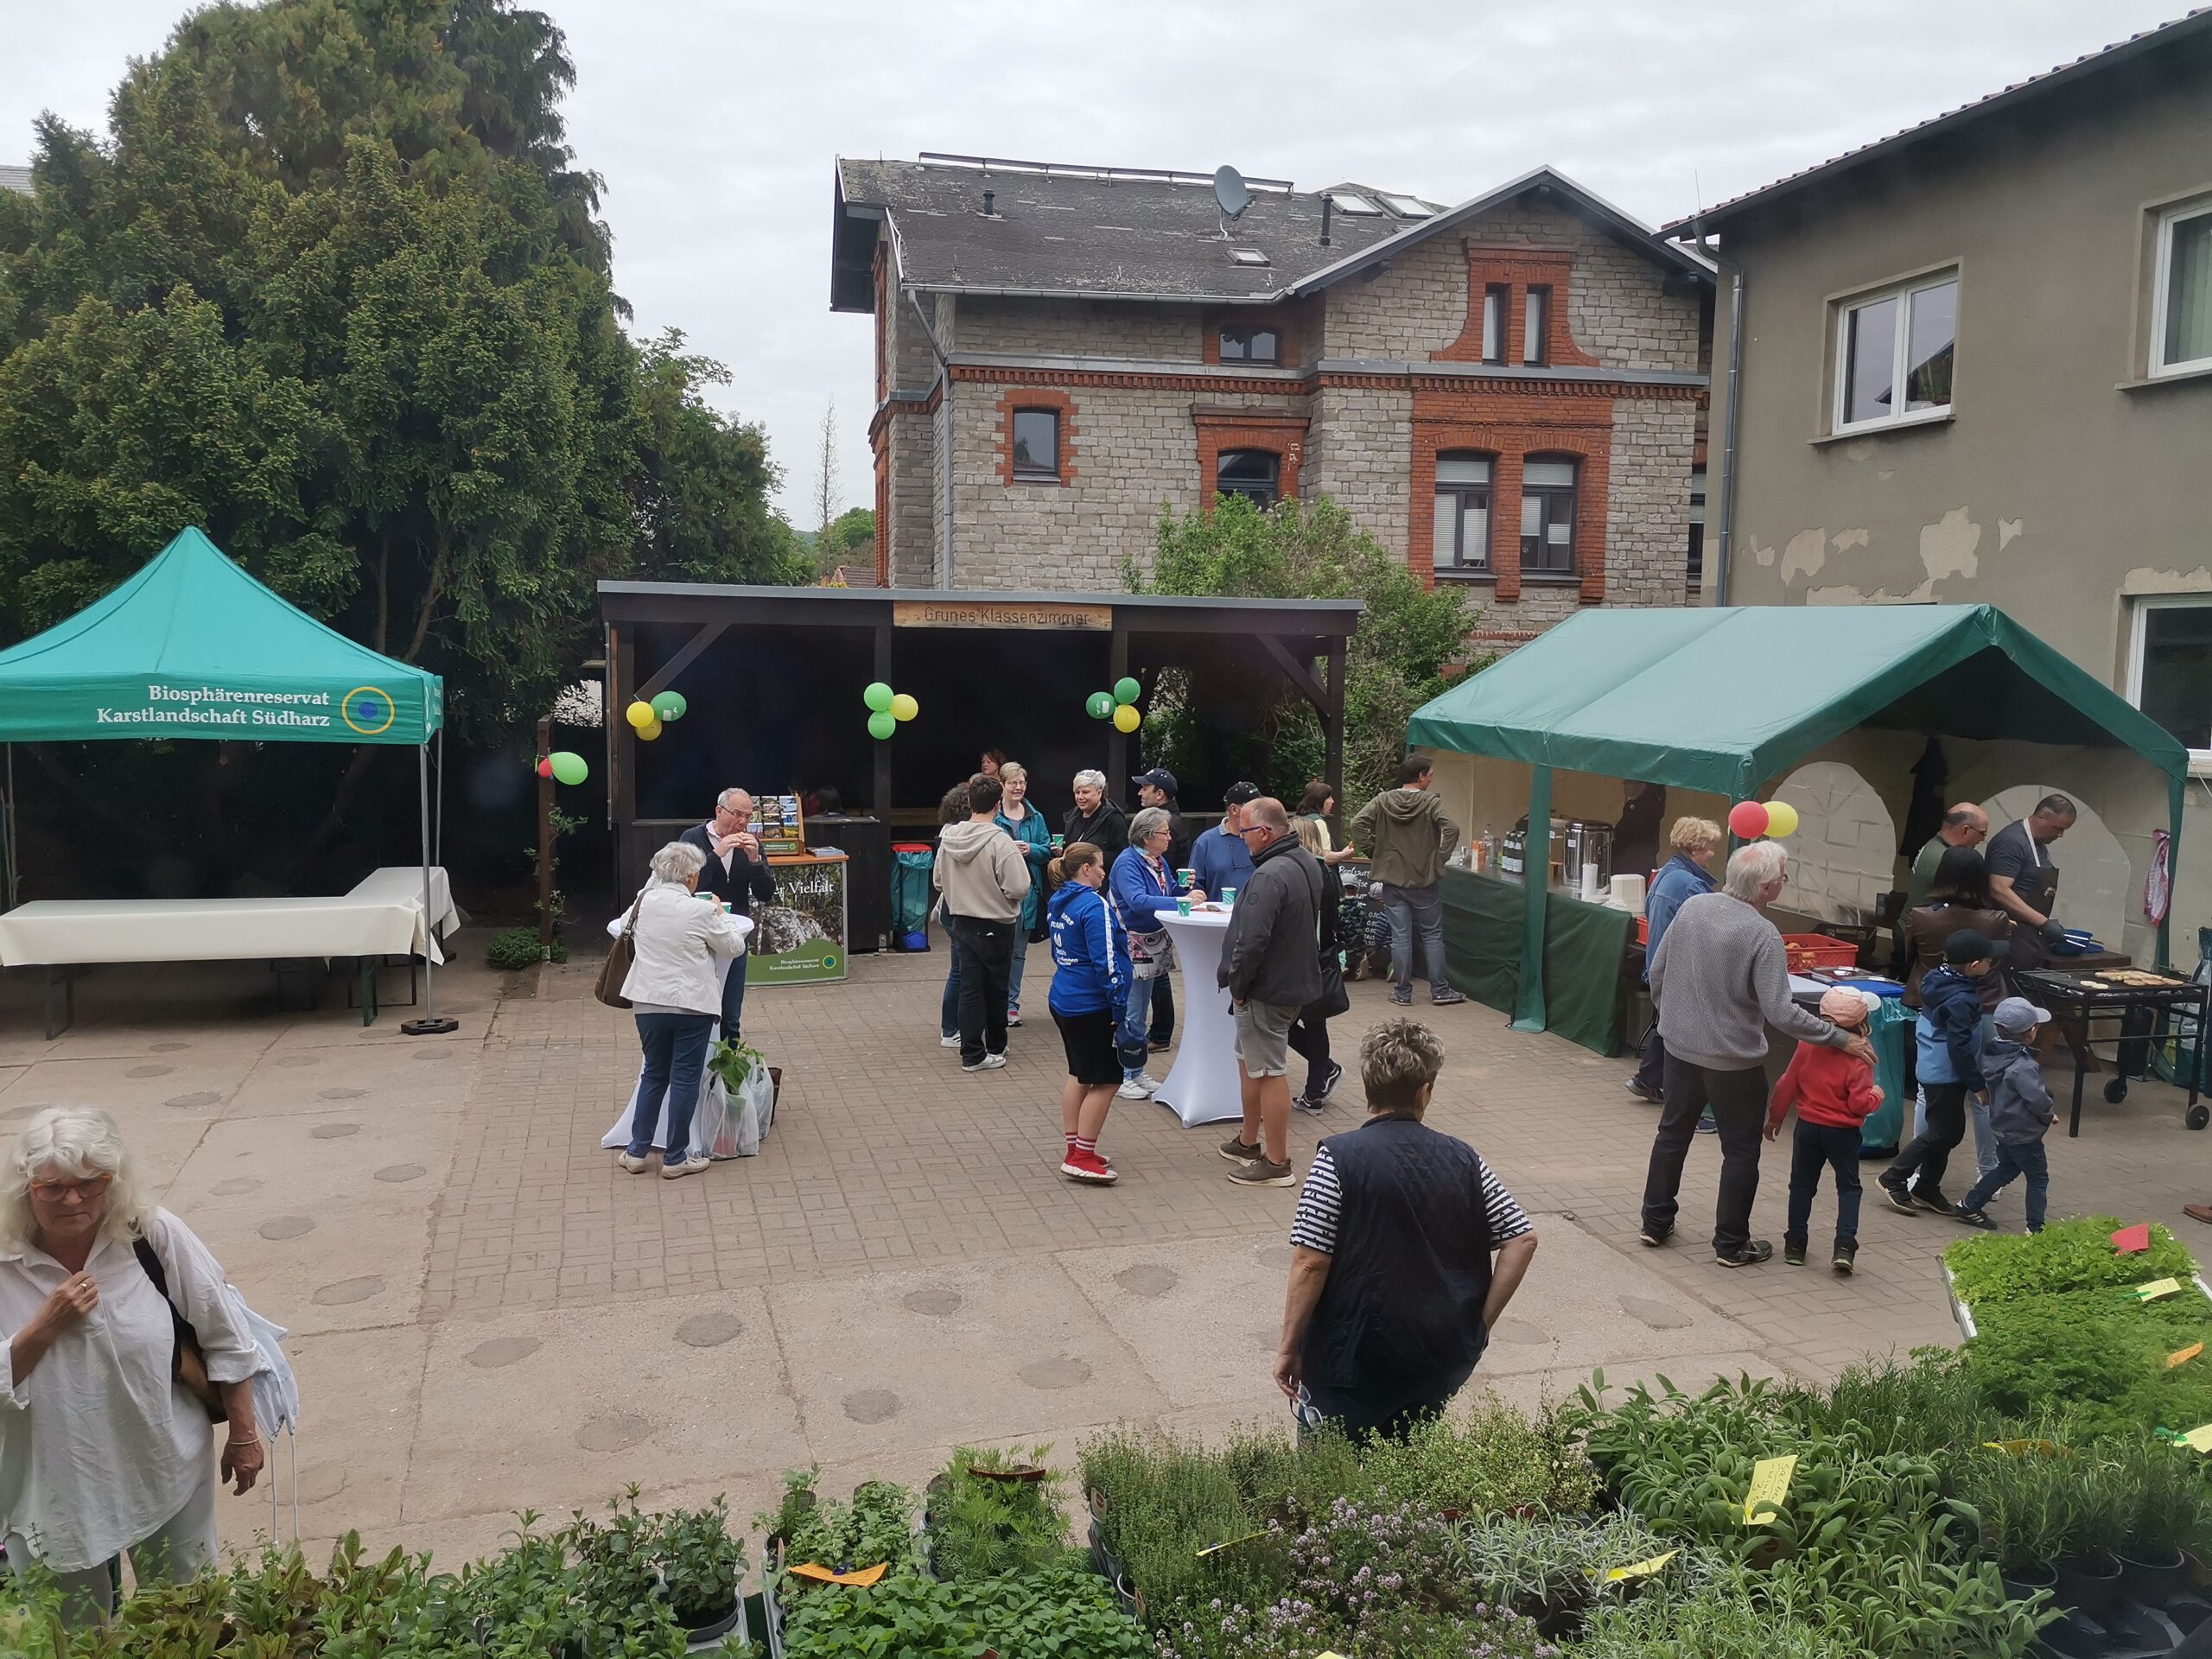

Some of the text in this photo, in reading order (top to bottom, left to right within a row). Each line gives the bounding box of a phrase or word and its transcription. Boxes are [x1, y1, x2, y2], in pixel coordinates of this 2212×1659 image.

[981, 607, 1090, 625] Klassenzimmer
[149, 684, 330, 706] Biosphärenreservat
[97, 708, 330, 728] Karstlandschaft Südharz
[788, 880, 835, 894] Vielfalt
